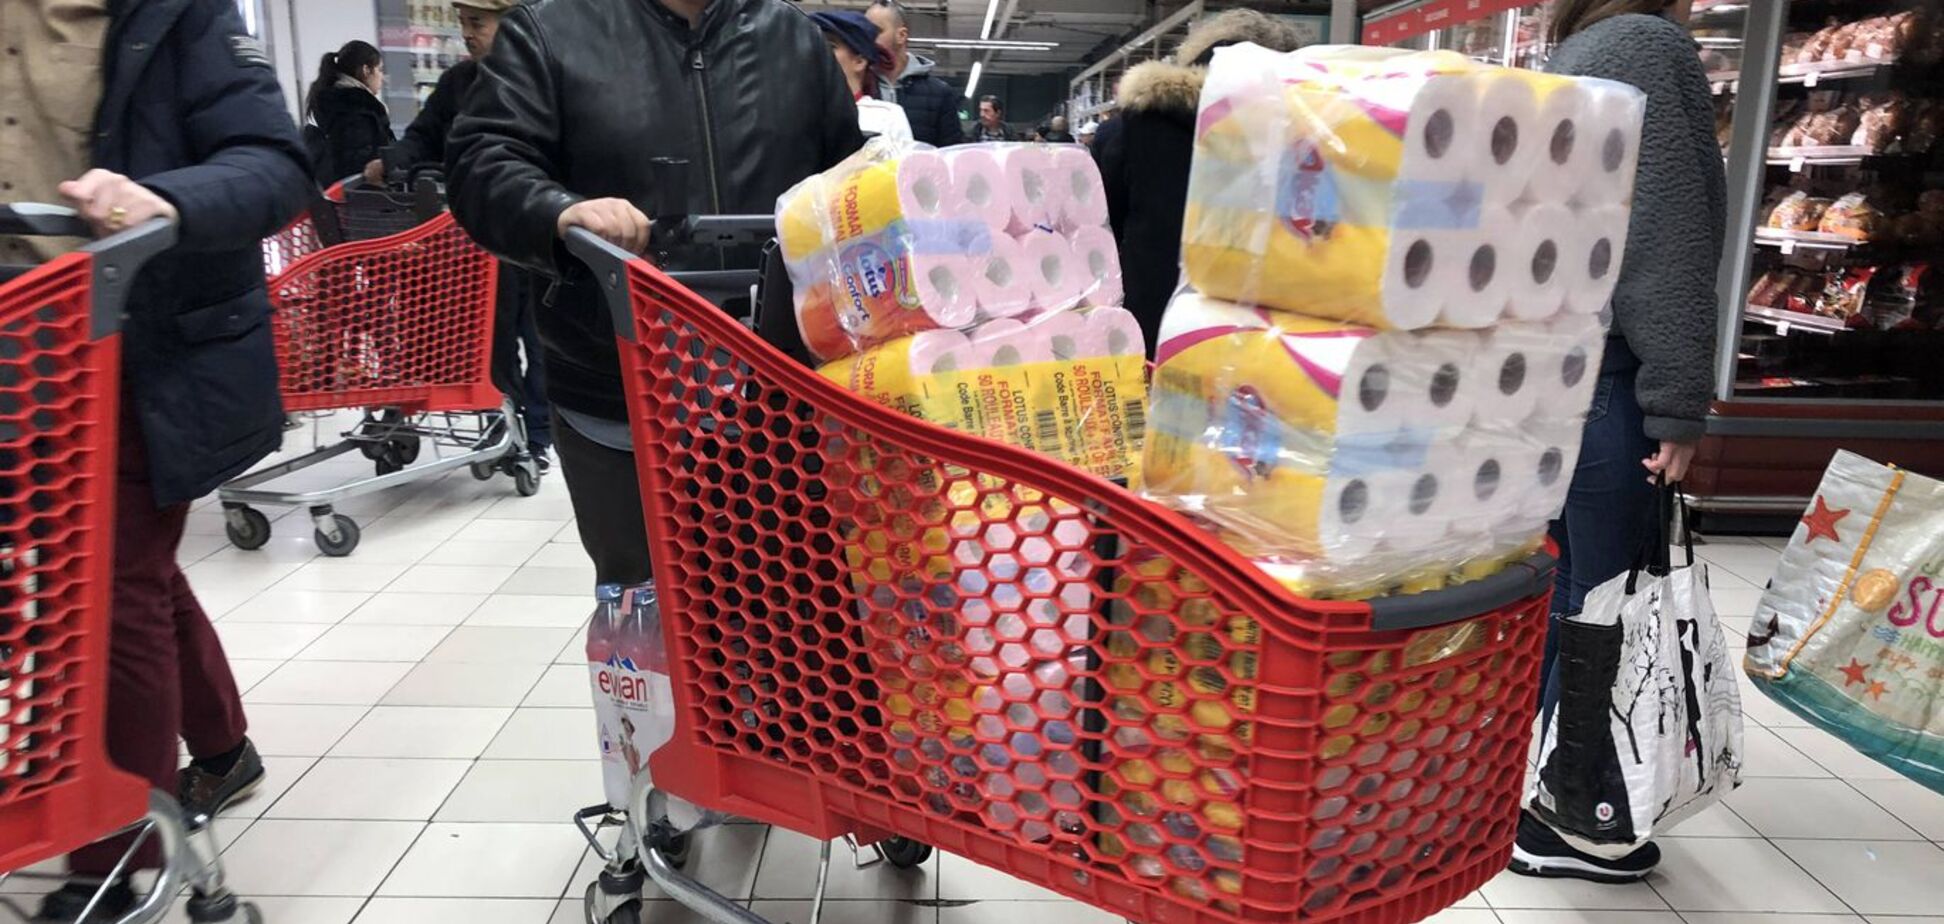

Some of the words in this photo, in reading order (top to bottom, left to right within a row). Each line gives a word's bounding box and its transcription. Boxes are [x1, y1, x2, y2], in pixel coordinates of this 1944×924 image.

[844, 184, 863, 238] FORMAT
[859, 249, 881, 298] Lotus
[842, 262, 870, 321] Confort
[978, 374, 992, 386] 50
[1054, 371, 1065, 394] Code
[1073, 364, 1087, 377] 50
[957, 382, 970, 405] Code
[997, 381, 1018, 436] FORMAT
[1059, 395, 1070, 418] Barre
[1091, 371, 1108, 426] FORMAT
[1104, 380, 1118, 412] LOTUS
[963, 406, 974, 429] Barre
[981, 388, 1003, 440] ROULEAU
[1012, 390, 1028, 423] LOTUS
[1020, 425, 1035, 450] CONF
[598, 670, 648, 702] evian
